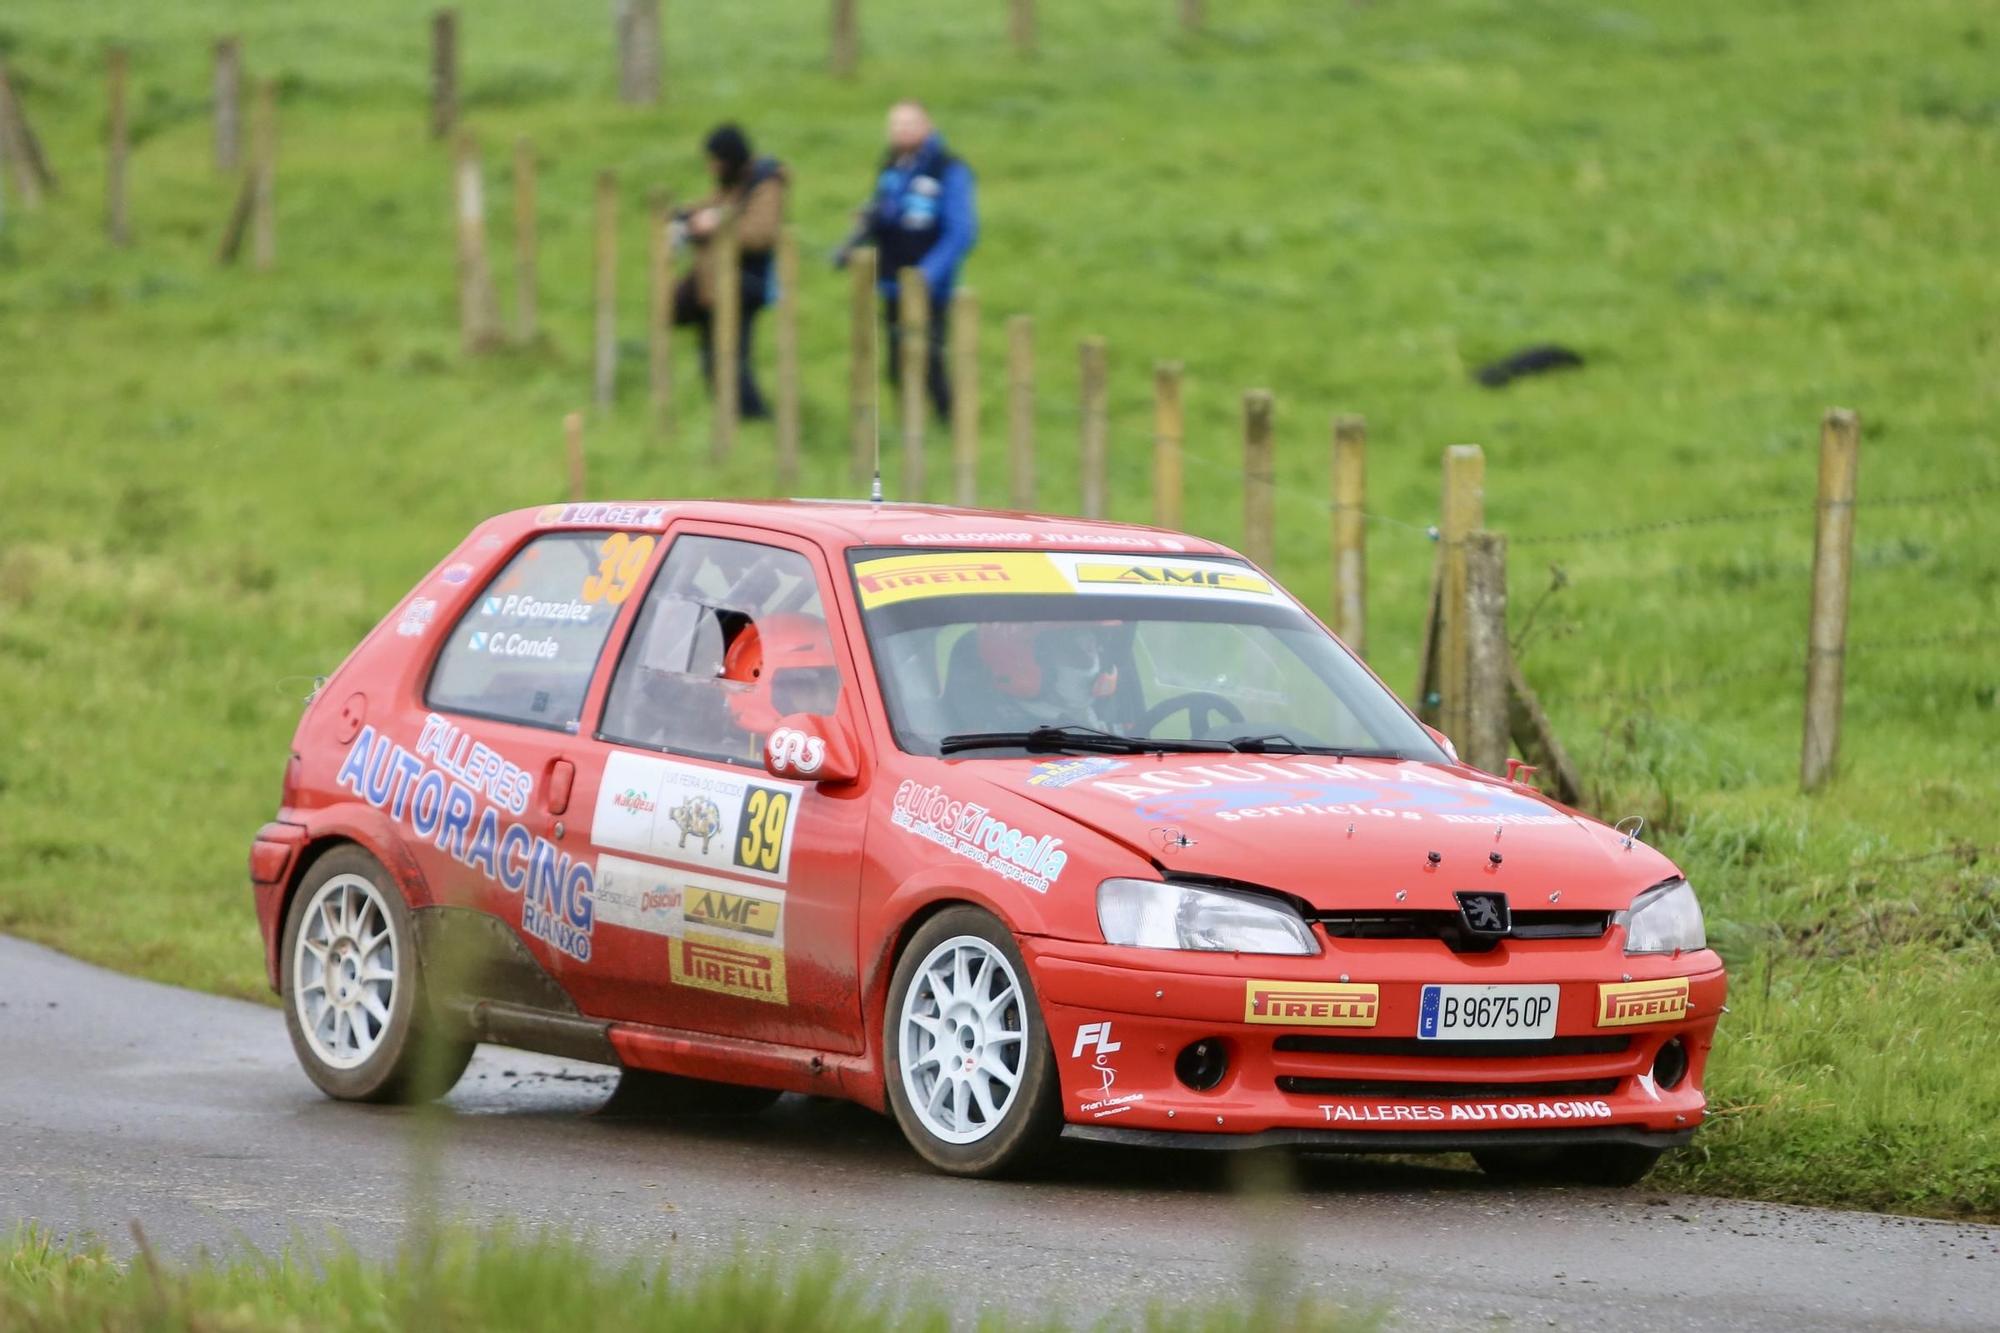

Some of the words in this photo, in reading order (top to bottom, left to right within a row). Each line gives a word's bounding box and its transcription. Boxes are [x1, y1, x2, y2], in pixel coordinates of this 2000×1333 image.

[559, 506, 649, 525] BURGER
[581, 532, 656, 604] 39
[858, 563, 1011, 593] PIRELLI
[1116, 566, 1238, 585] AMF
[501, 594, 592, 620] P.Gonzalez
[488, 631, 560, 657] C.Conde
[416, 713, 533, 816] TALLERES
[1215, 803, 1423, 822] servicios
[337, 724, 594, 935] AUTORACING
[741, 789, 787, 870] 39
[894, 780, 962, 831] autos
[974, 816, 1067, 881] rosalía
[692, 891, 761, 925] AMF
[522, 901, 593, 962] RIANXO
[681, 940, 772, 993] PIRELLI
[1254, 991, 1374, 1018] PIRELLI
[1425, 1018, 1433, 1029] E
[1443, 997, 1459, 1028] B
[1463, 997, 1519, 1028] 9675
[1523, 996, 1552, 1028] OP
[1606, 990, 1687, 1019] PIRELLI
[1071, 1021, 1122, 1058] FL
[1080, 1100, 1102, 1112] Fran
[1319, 1105, 1444, 1121] TALLERES
[1450, 1101, 1611, 1120] AUTORACING
